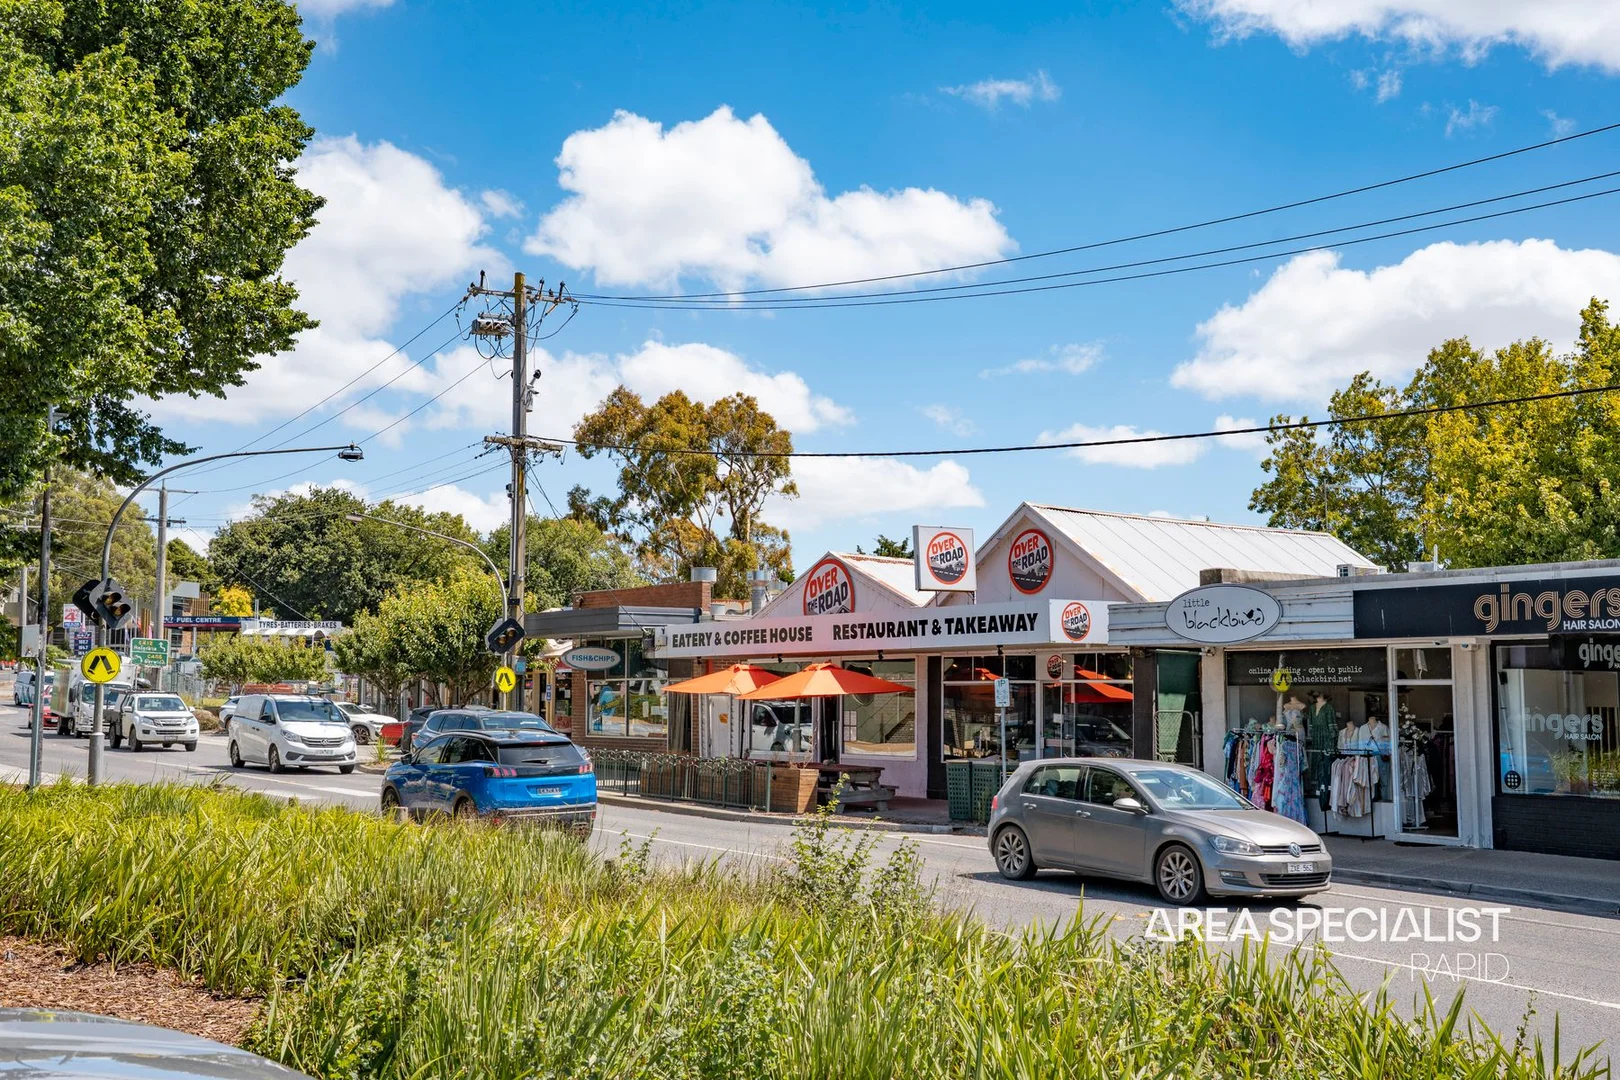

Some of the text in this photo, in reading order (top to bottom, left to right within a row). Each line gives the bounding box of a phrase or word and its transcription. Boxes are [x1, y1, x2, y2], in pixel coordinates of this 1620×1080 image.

[931, 538, 955, 554] OVER
[940, 547, 964, 565] ROAD
[1014, 535, 1039, 559] OVER
[1021, 546, 1048, 570] ROAD
[810, 567, 838, 598] OVER
[807, 581, 848, 614] THE ROAD
[1183, 599, 1210, 608] little
[1474, 584, 1620, 633] gingers
[1065, 606, 1081, 619] OVER
[1070, 613, 1087, 626] ROAD
[1183, 606, 1265, 630] blackbird
[833, 613, 1038, 640] RESTAURANT & TAKEAWAY
[1563, 620, 1587, 630] HAIR
[672, 626, 813, 648] EATERY & COFFEE HOUSE
[571, 654, 615, 662] FISH&CHIPS
[1249, 667, 1272, 675] online
[1338, 666, 1363, 674] public
[1508, 706, 1604, 740] ingers
